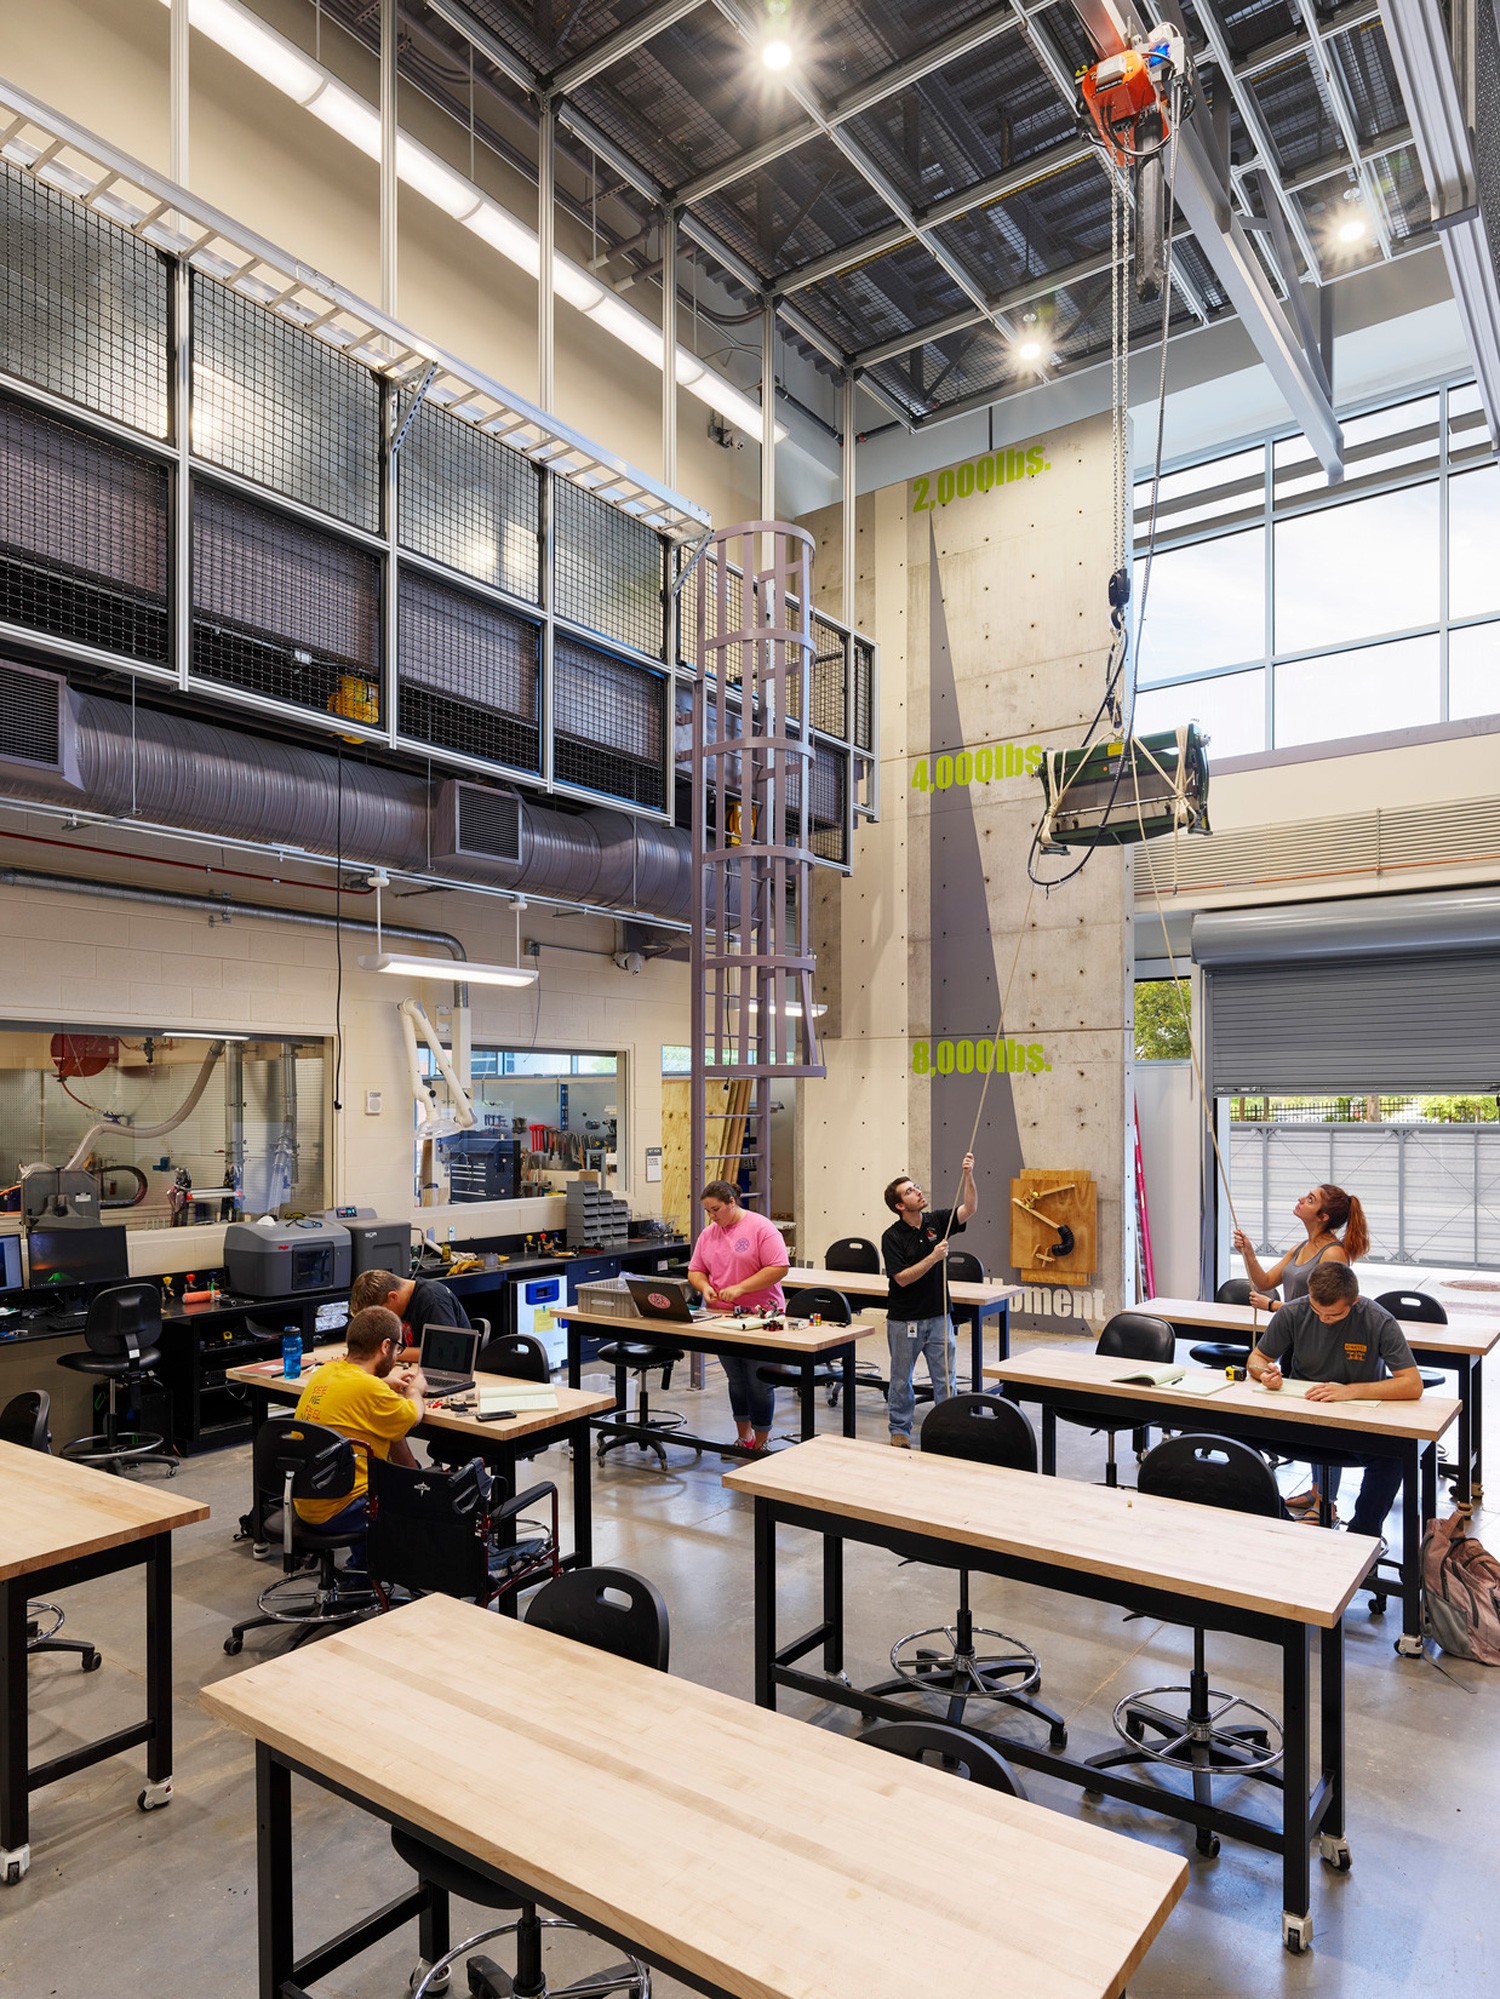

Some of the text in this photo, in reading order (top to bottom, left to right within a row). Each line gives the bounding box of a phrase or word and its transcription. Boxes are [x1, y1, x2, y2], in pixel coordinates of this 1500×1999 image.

[913, 445, 1051, 512] 2,000lbs.
[911, 743, 1042, 794] 4,000lbs
[912, 1039, 1052, 1077] 8,000lbs.
[983, 1276, 1106, 1321] oment
